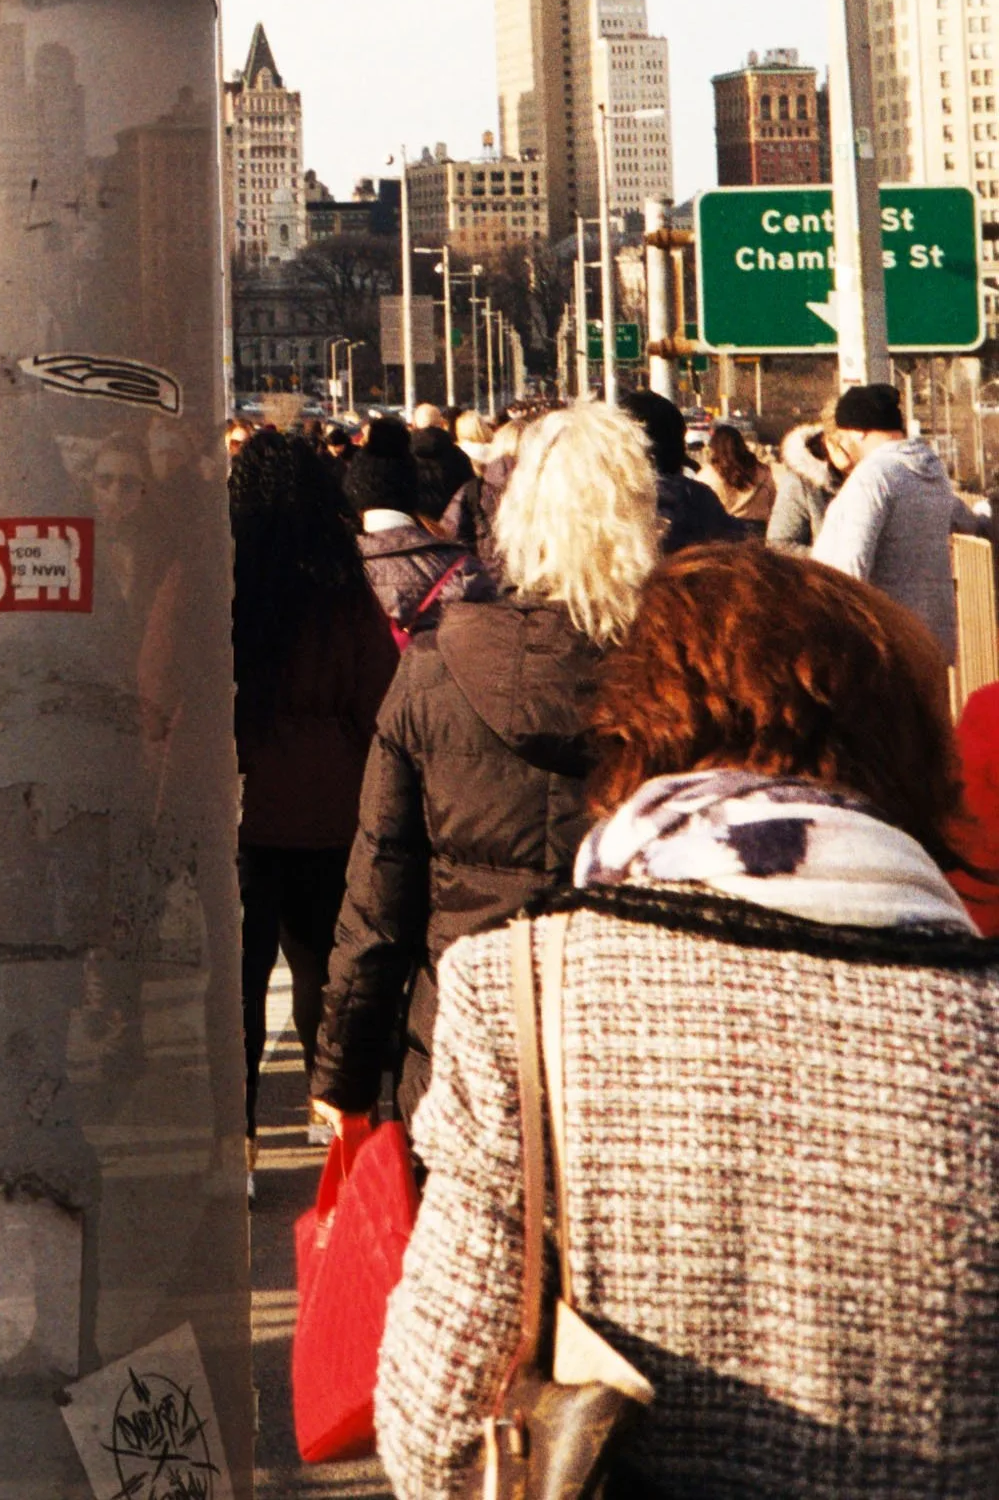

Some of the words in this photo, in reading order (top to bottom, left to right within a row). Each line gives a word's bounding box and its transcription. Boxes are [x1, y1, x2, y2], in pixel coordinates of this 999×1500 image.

[761, 208, 836, 234] Cent
[880, 207, 915, 232] St
[735, 246, 897, 271] Chambs
[909, 244, 945, 269] St
